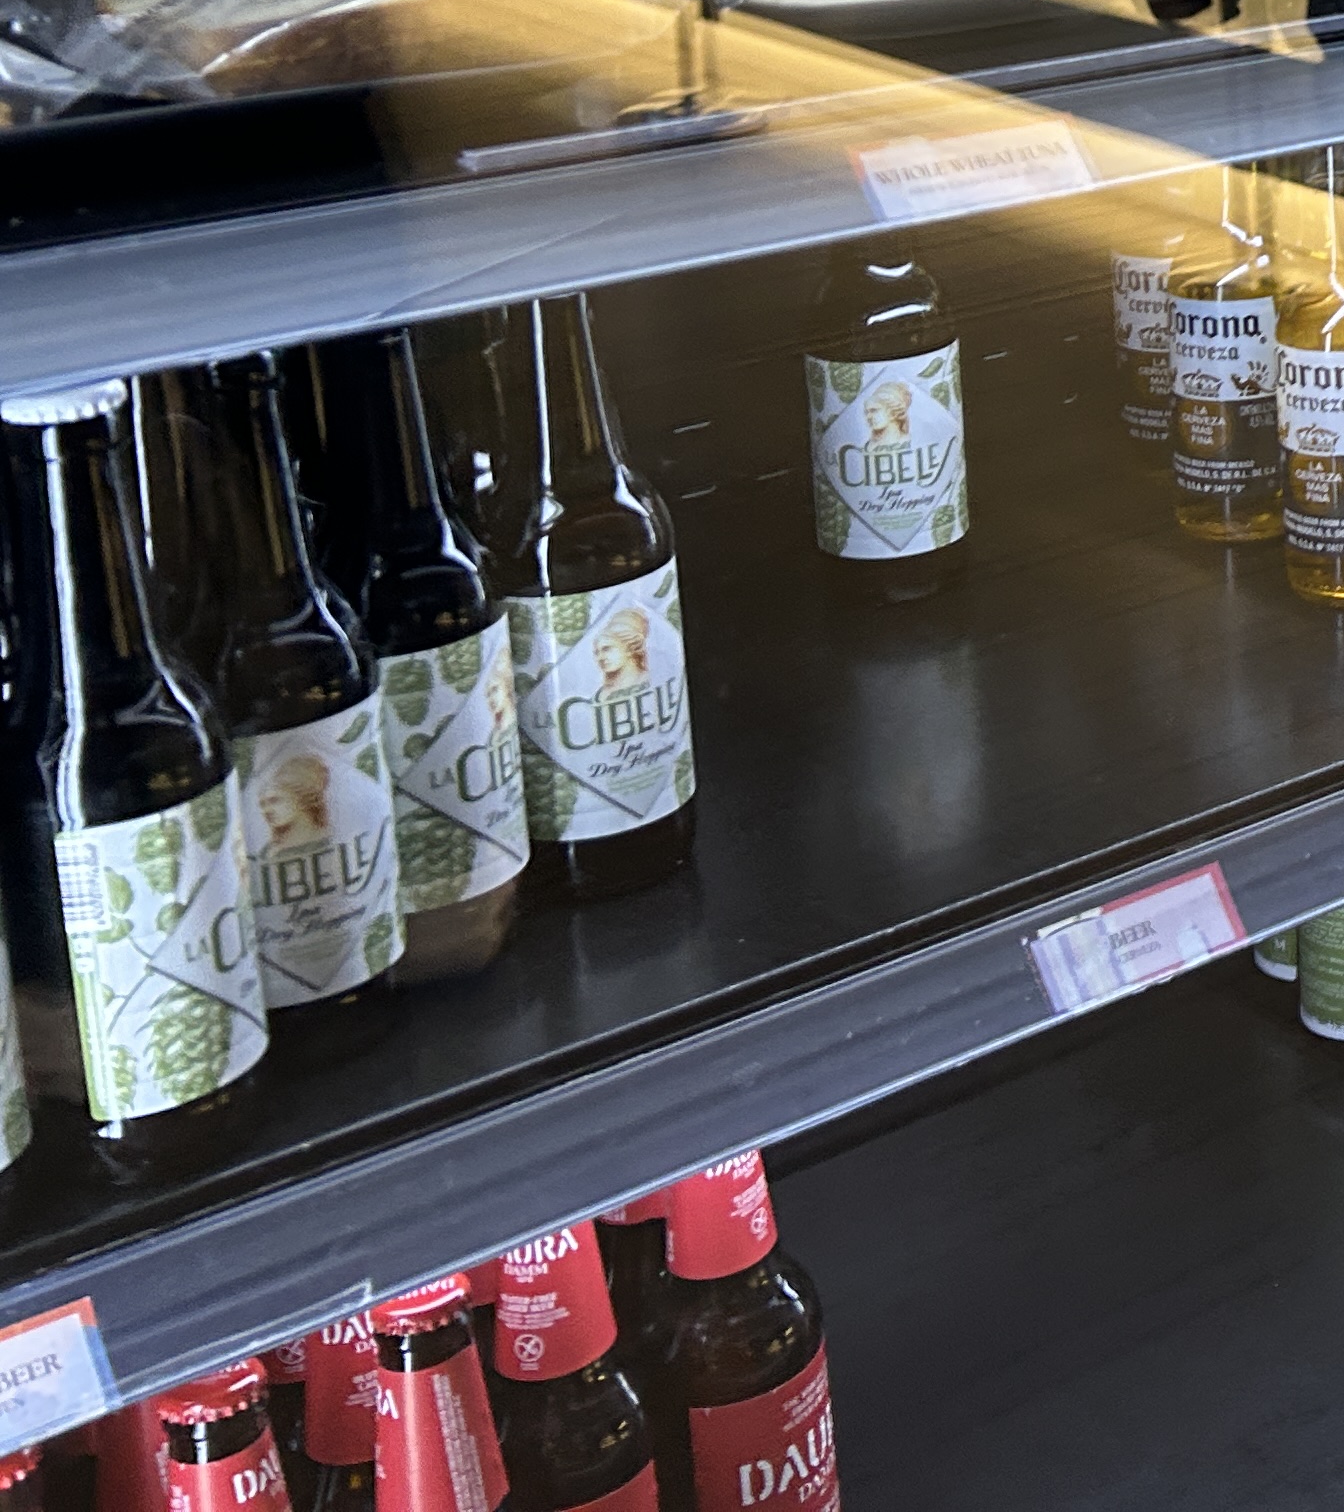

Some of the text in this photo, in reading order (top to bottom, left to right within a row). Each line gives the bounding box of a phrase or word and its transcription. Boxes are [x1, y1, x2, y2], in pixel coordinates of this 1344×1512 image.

[875, 161, 943, 185] WHOLE
[951, 149, 1014, 173] WHEAT
[1020, 141, 1068, 162] TUNA
[1176, 342, 1240, 361] cerveza
[858, 499, 884, 512] Dry
[588, 762, 622, 778] Dry
[247, 816, 391, 909] IBELES
[1109, 920, 1157, 949] BEER
